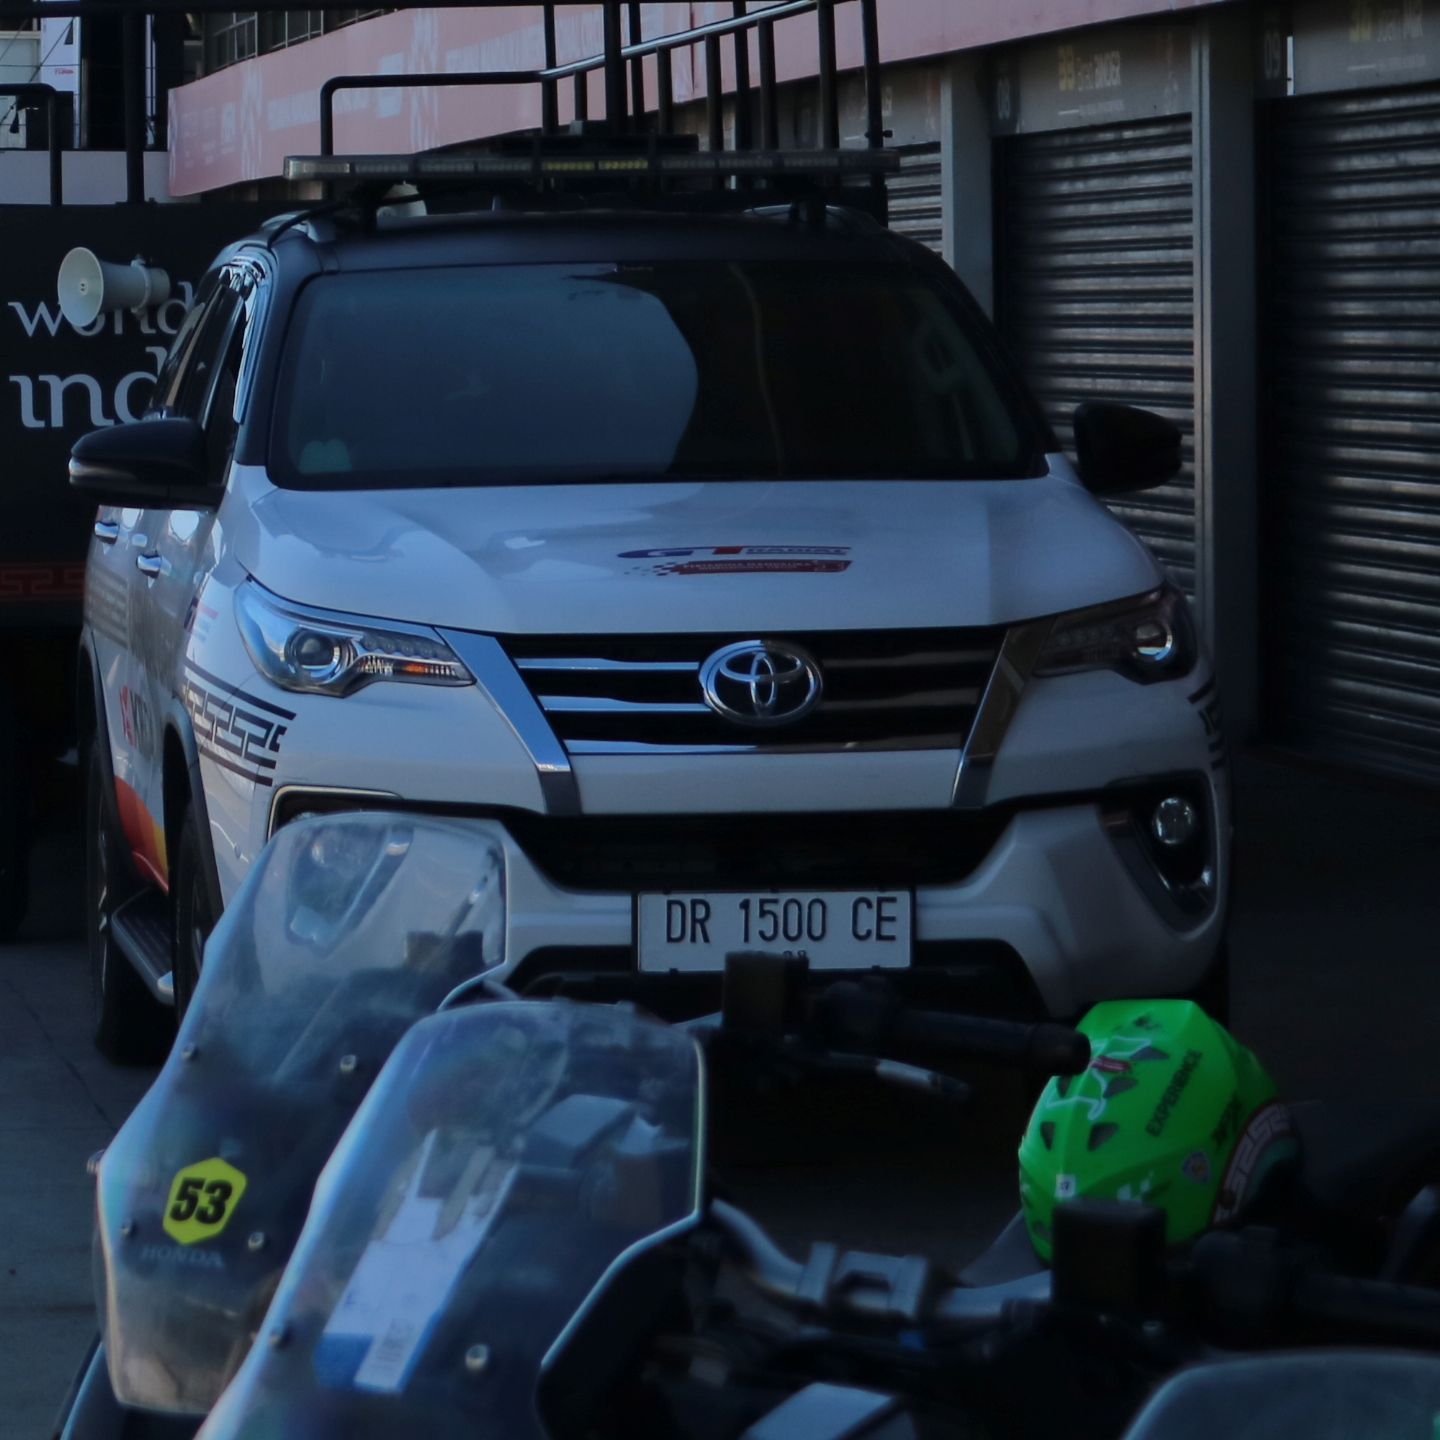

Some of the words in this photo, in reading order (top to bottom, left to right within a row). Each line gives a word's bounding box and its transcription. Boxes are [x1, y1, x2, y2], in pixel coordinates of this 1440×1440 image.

[666, 898, 711, 943] DR
[739, 897, 827, 942] 1500
[851, 895, 898, 942] CE
[170, 1177, 233, 1224] 53
